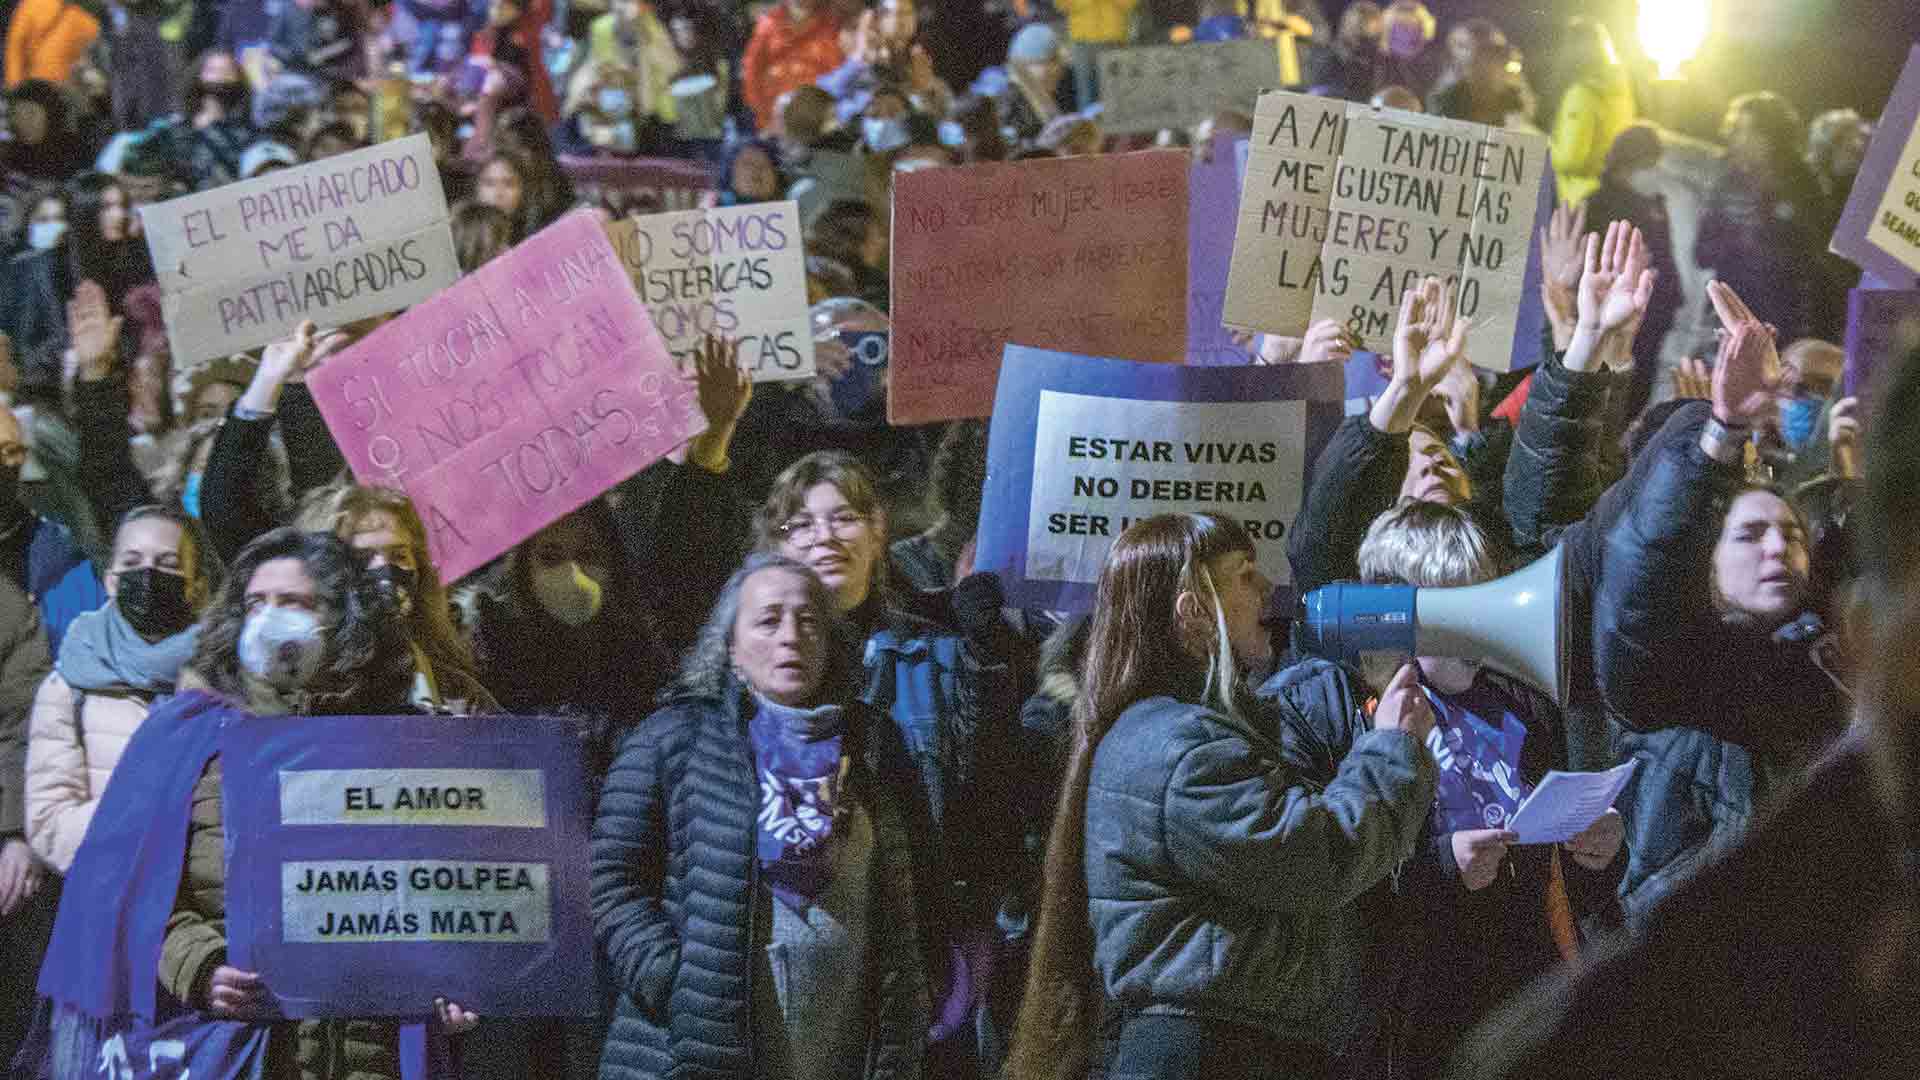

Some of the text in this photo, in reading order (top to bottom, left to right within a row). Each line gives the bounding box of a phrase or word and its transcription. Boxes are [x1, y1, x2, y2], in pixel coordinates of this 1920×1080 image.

[1269, 105, 1298, 148] A
[1378, 125, 1525, 185] TAMBIEN
[1271, 160, 1513, 225] ME GUSTAN LAS
[183, 209, 226, 249] EL
[257, 214, 364, 270] ME DA
[671, 212, 787, 260] SOMOS
[1261, 200, 1504, 271] MUJERES Y NO
[639, 256, 774, 304] ISTÉRICAS
[1277, 250, 1481, 318] LAS ACO
[648, 299, 740, 341] OMOS
[1349, 303, 1390, 338] 8M
[342, 374, 393, 431] SI
[516, 287, 546, 323] A
[416, 380, 508, 464] NOS
[429, 388, 637, 553] A TODAS
[1068, 436, 1277, 464] ESTAR VIVAS
[1073, 475, 1267, 502] NO DEBERIA
[1048, 512, 1110, 537] SER
[345, 786, 488, 811] EL AMOR
[296, 865, 534, 893] JAMÁS GOLPEA
[317, 906, 519, 936] JAMÁS MATA
